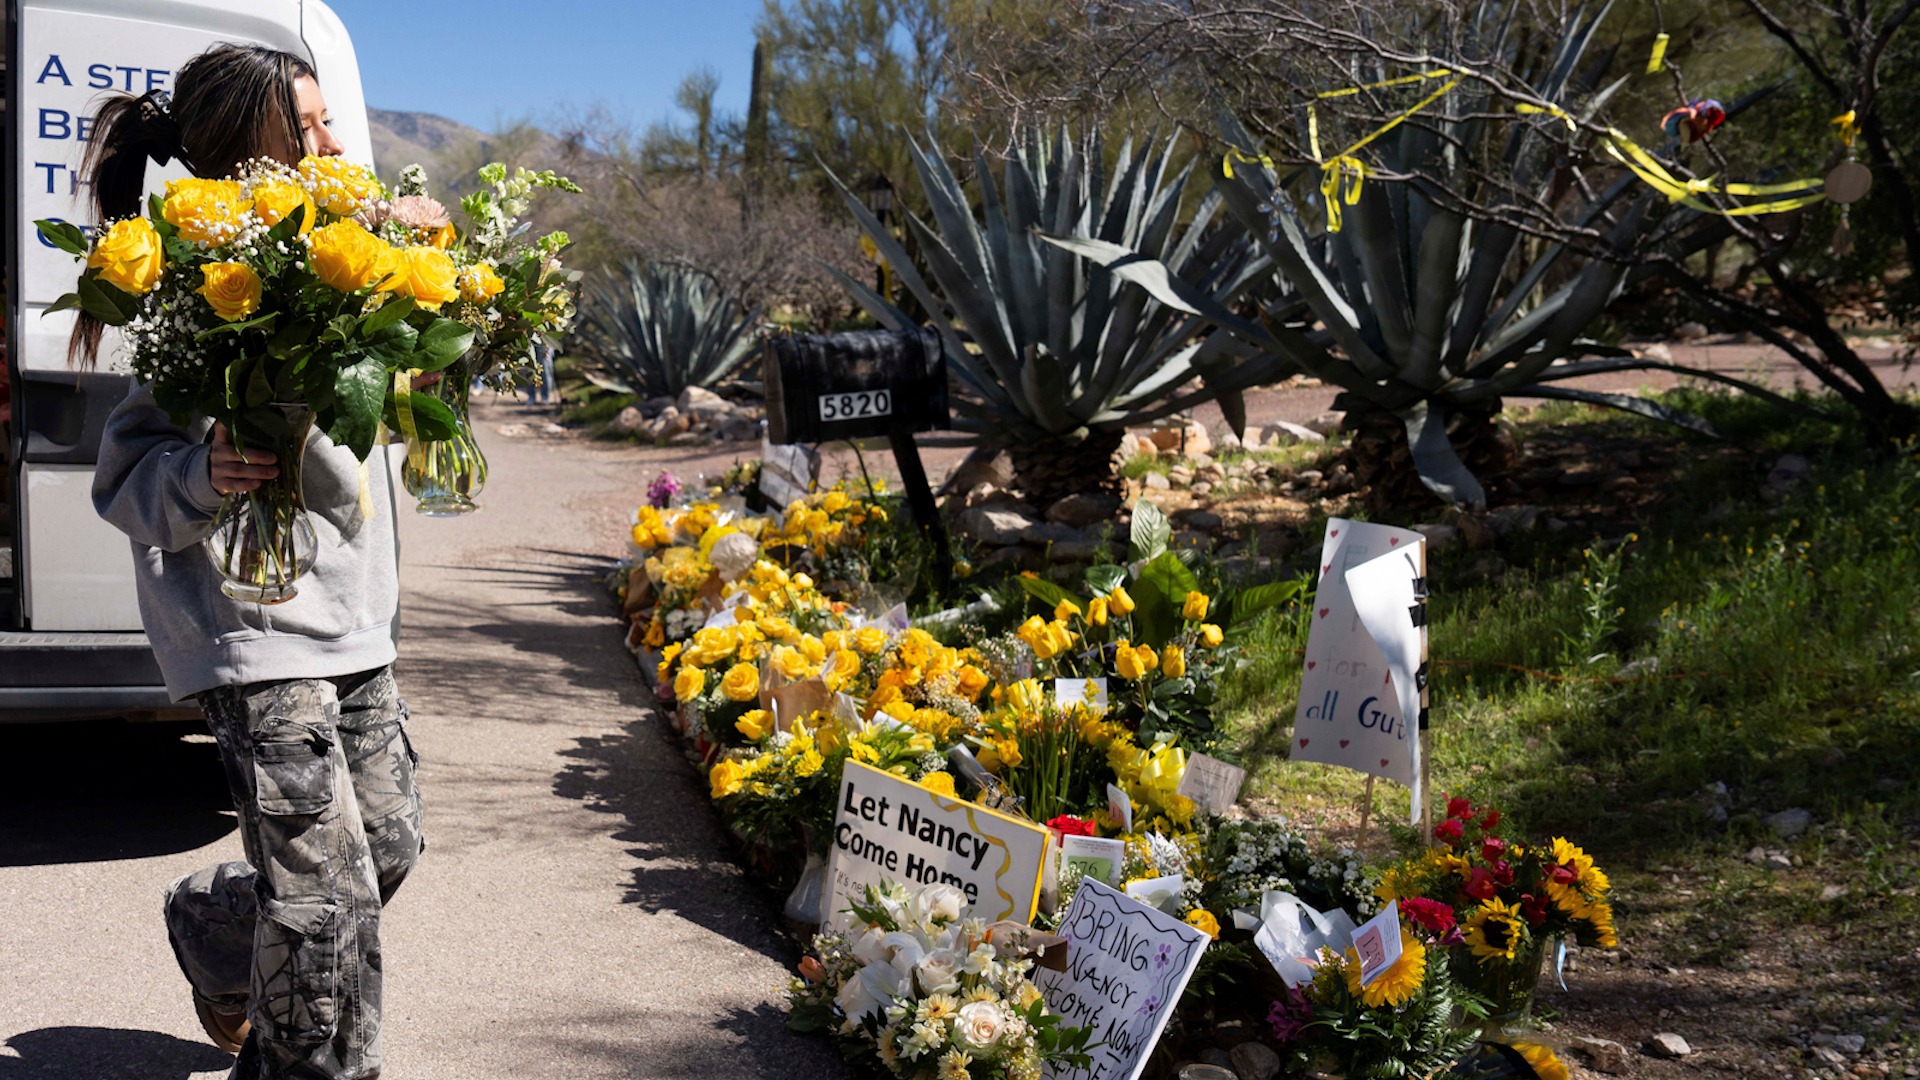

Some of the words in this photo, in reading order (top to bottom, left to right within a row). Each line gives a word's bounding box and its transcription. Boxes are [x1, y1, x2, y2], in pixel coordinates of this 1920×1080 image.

[36, 54, 72, 87] A
[88, 63, 178, 97] STE
[823, 392, 889, 418] 5820
[1306, 690, 1339, 722] all
[1358, 696, 1406, 740] Gut
[843, 781, 890, 827] Let
[898, 803, 989, 871] Nancy
[835, 822, 898, 872] Come
[905, 853, 979, 905] Home
[1070, 892, 1150, 971] BRING
[1068, 947, 1137, 1009] NANCY
[1102, 1017, 1136, 1059] NOW
